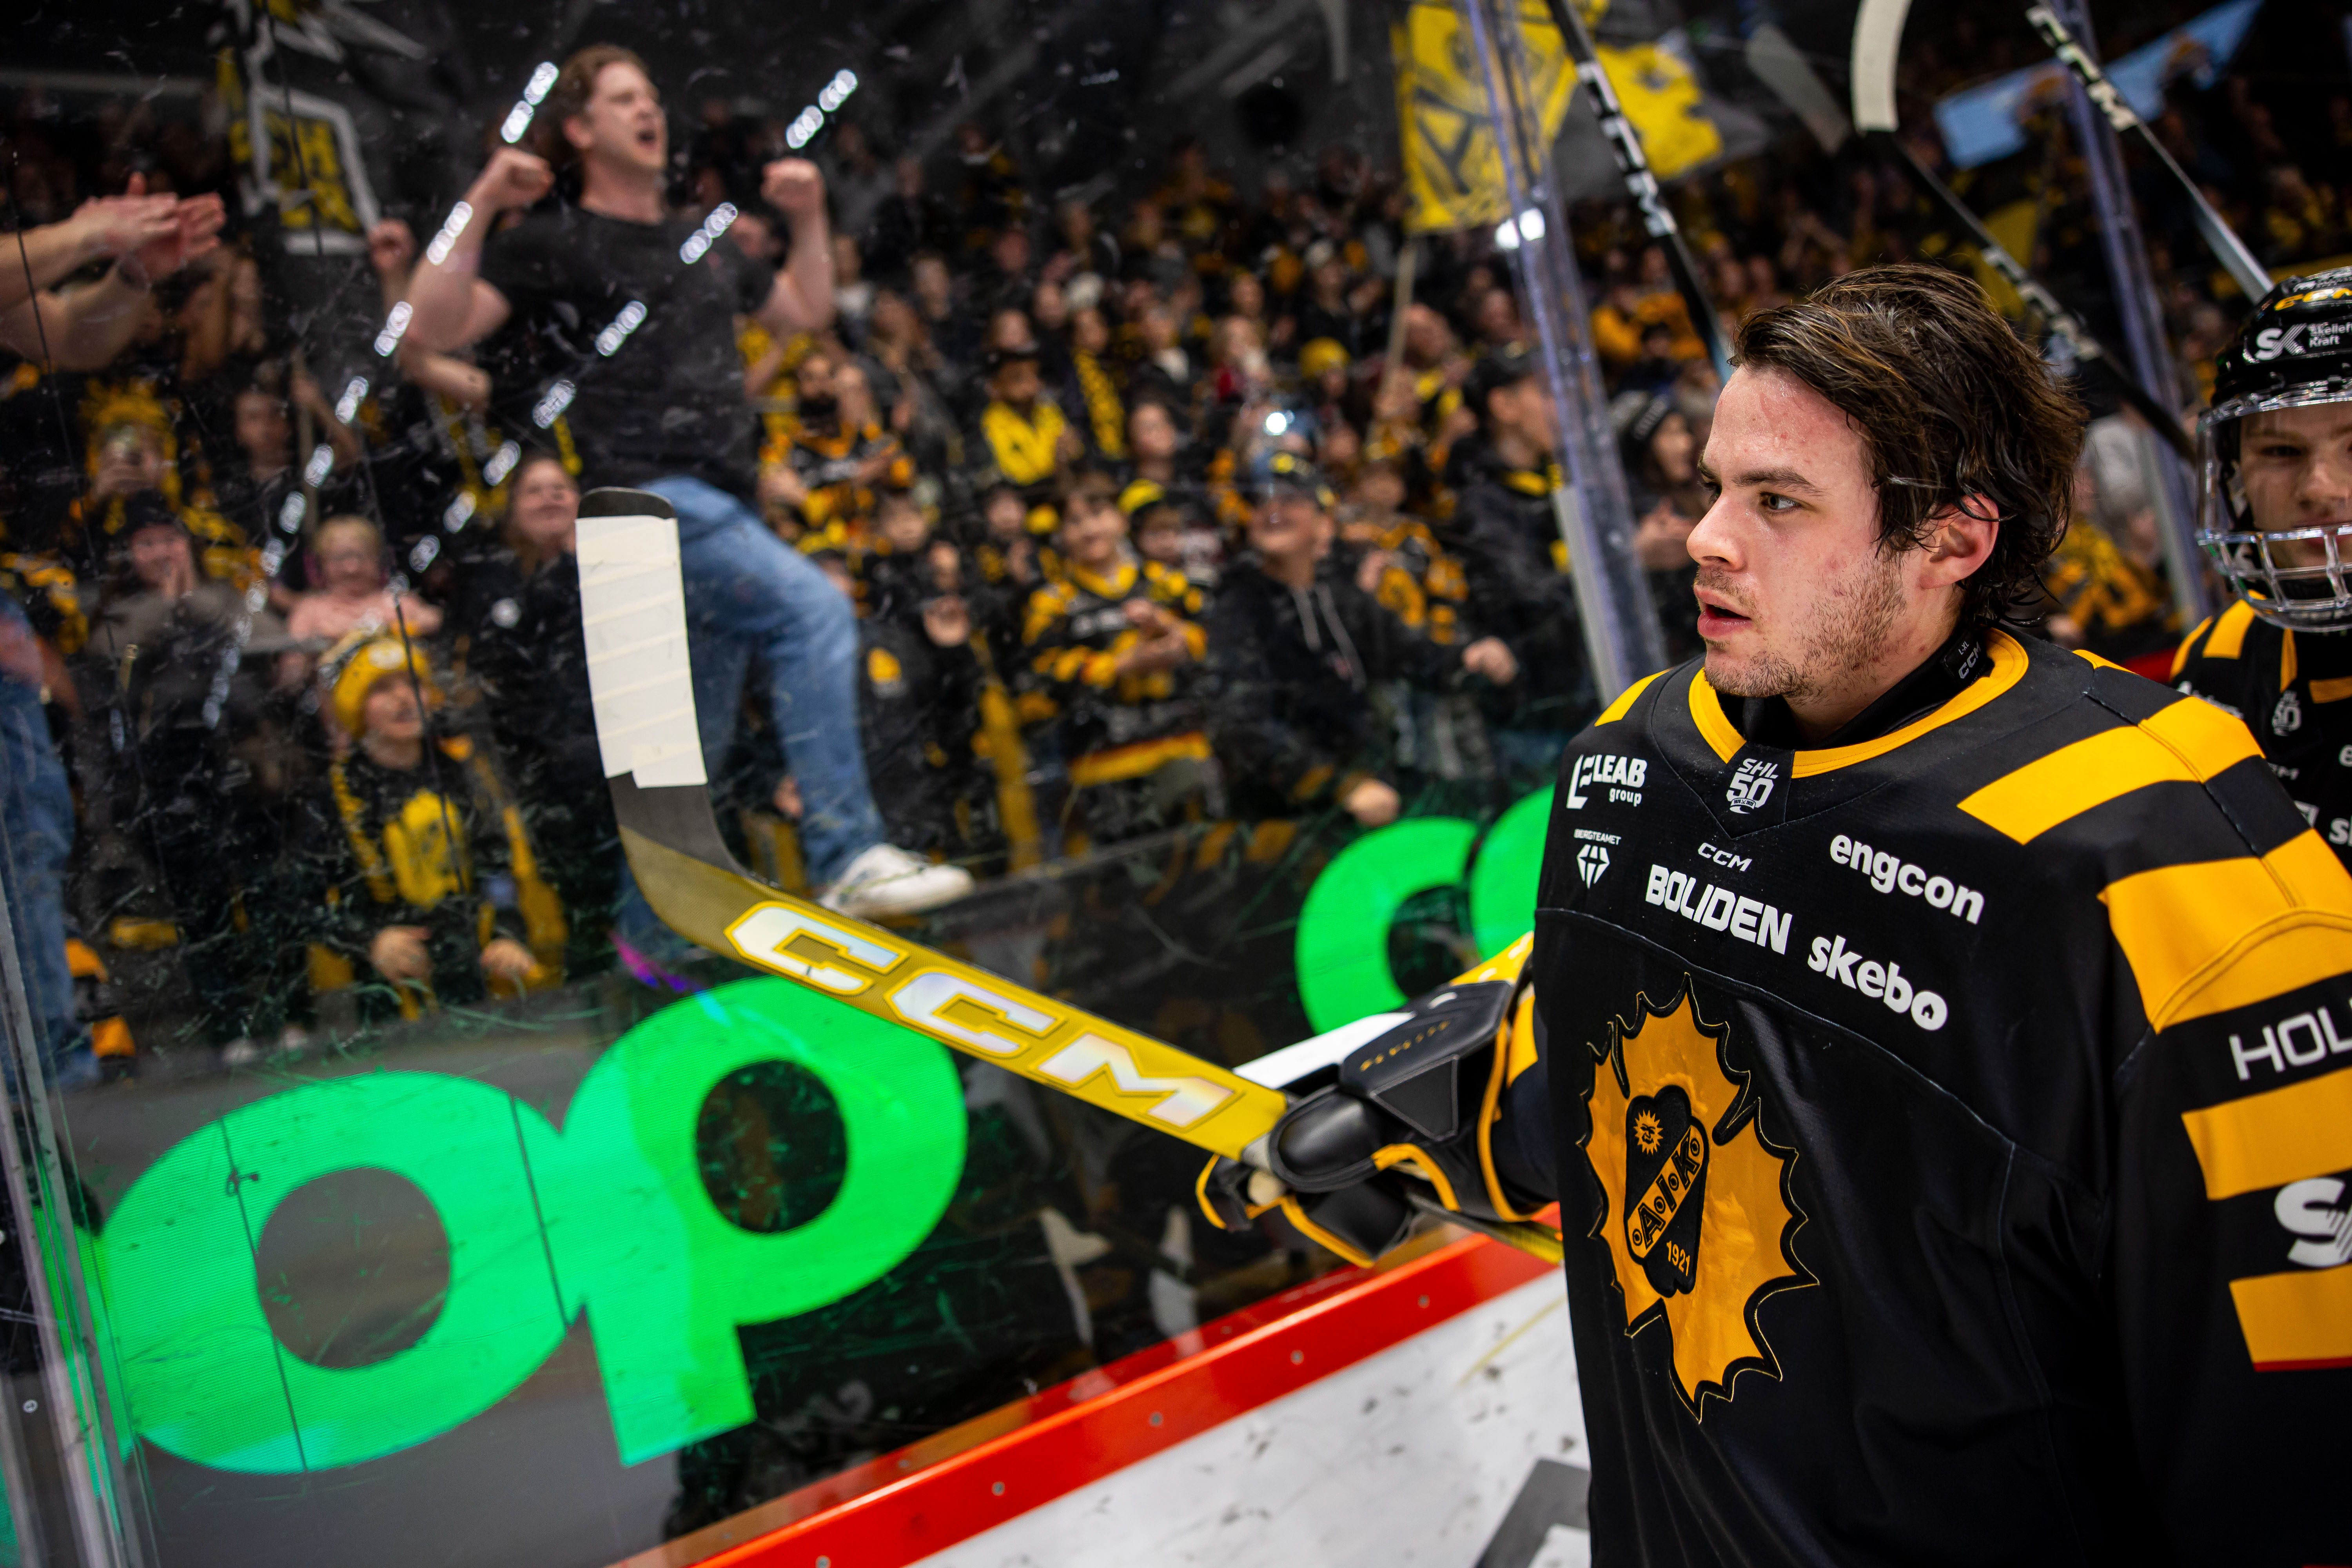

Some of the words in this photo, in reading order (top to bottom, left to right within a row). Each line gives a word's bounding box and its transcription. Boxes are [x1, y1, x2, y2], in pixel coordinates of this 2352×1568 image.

[1958, 641, 1981, 679] CCM
[1737, 758, 1779, 779] SHL
[1609, 788, 1642, 807] group
[1726, 772, 1774, 808] 50
[1698, 842, 1752, 872] CCM
[1829, 834, 1985, 925] engcon
[1645, 864, 1793, 955] BOLIDEN
[1807, 935, 1948, 1031] skebo
[725, 901, 1243, 1130] CCM
[2229, 997, 2352, 1081] HOL
[1666, 1240, 1690, 1276] 1921
